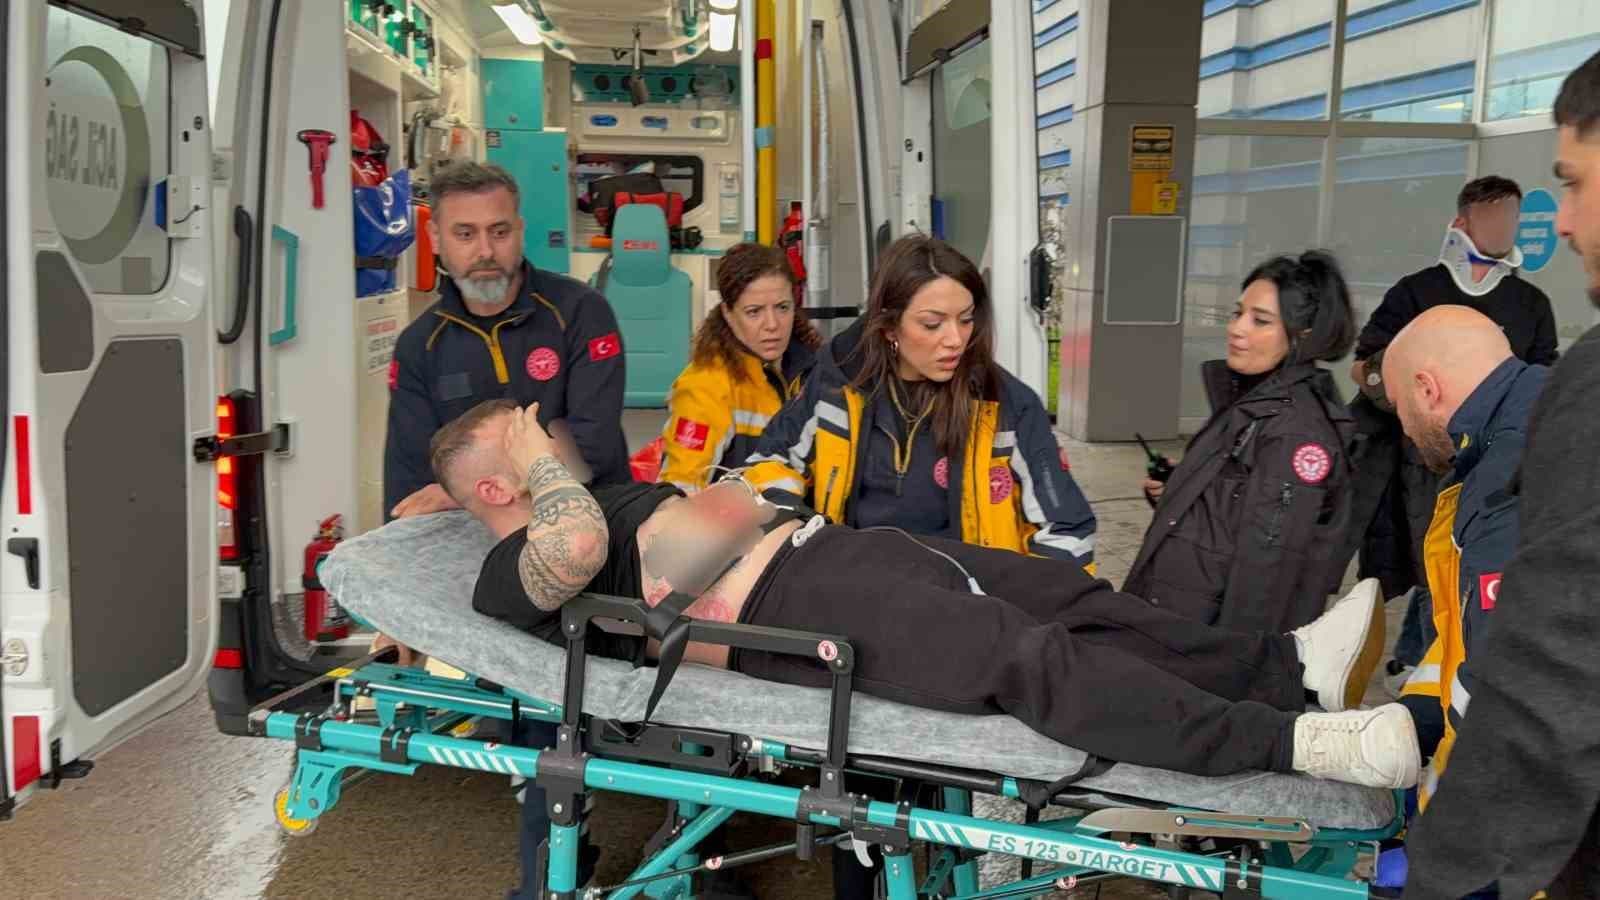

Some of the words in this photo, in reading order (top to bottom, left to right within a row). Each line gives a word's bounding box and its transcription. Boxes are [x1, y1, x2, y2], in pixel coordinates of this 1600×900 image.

[987, 833, 1017, 852] ES
[1024, 840, 1060, 861] 125
[1079, 850, 1172, 880] TARGET
